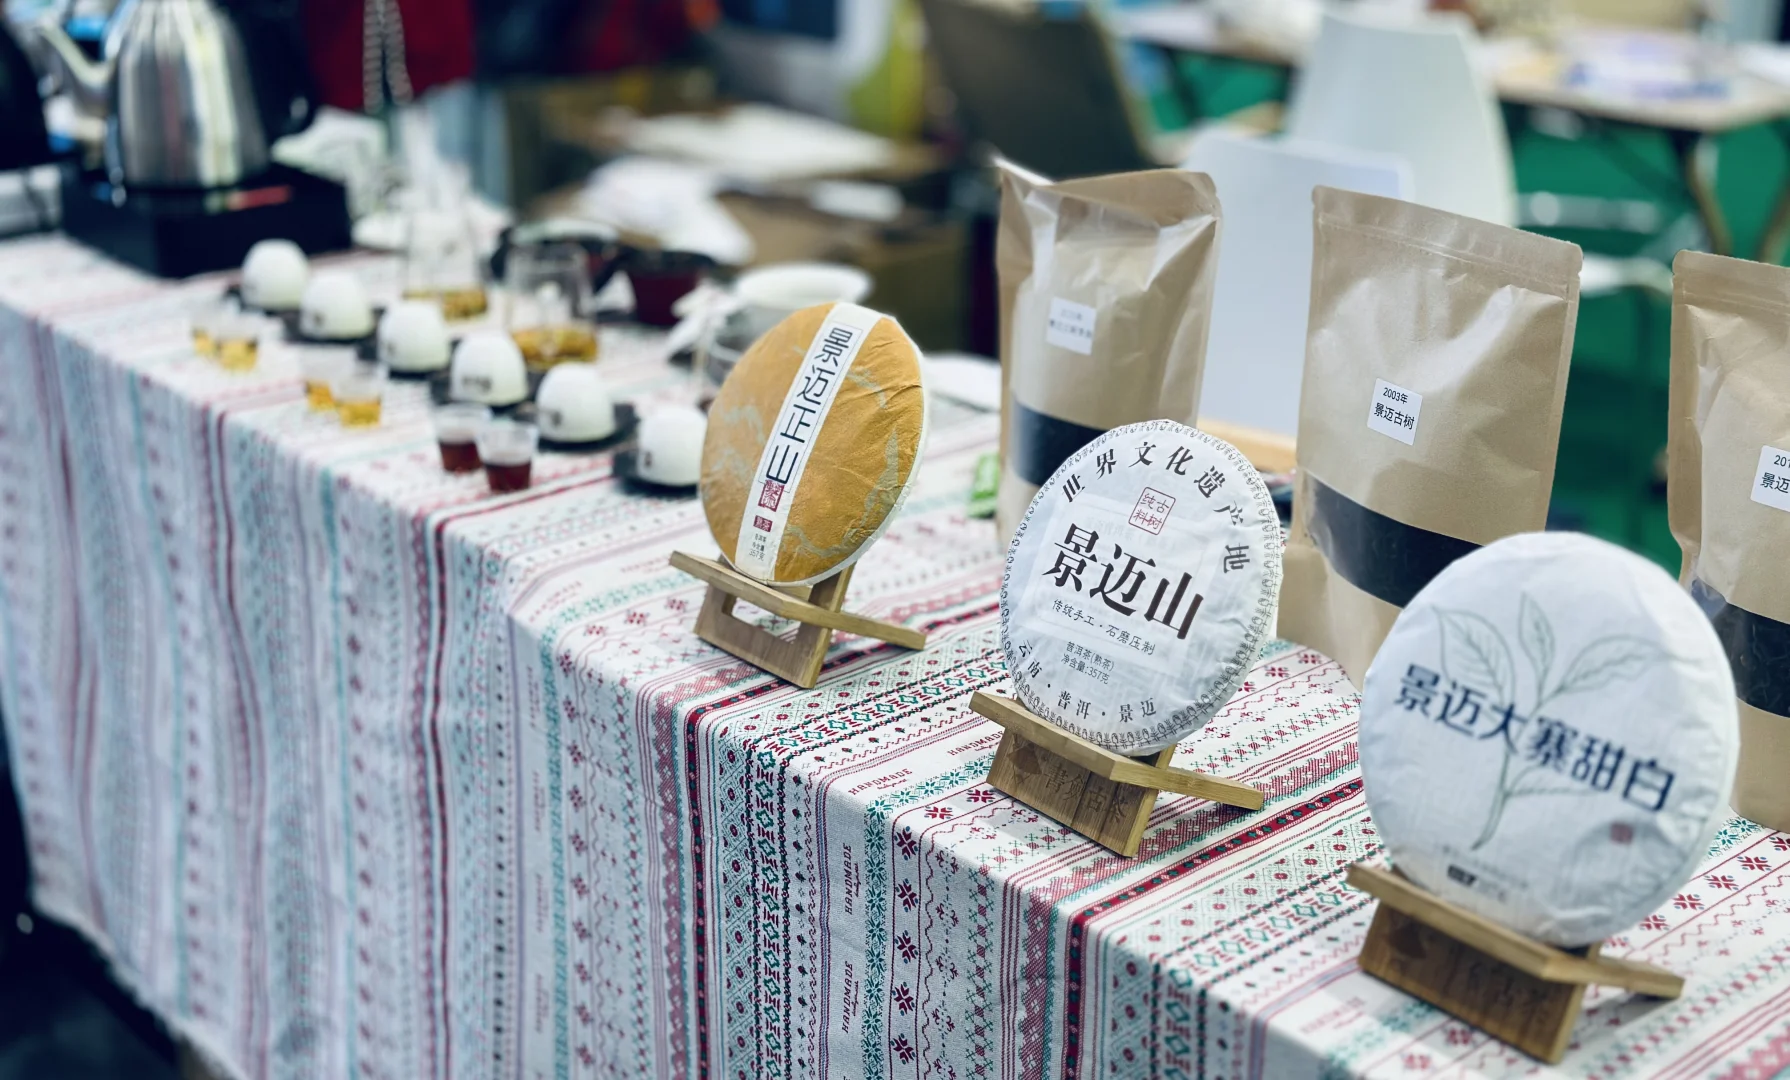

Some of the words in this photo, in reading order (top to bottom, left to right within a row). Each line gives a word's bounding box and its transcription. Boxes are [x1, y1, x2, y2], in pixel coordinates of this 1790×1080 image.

[766, 327, 853, 485] 景迈正山
[1374, 402, 1415, 430] 景迈古树
[1383, 387, 1408, 404] 2003年
[1062, 441, 1250, 574] 世界文化遗产地
[1042, 523, 1204, 640] 景迈山
[1395, 663, 1675, 812] 景迈大寨甜白
[848, 768, 913, 795] HANDMADE
[843, 843, 853, 915] HANDMADE
[841, 961, 853, 1034] HANDMADE
